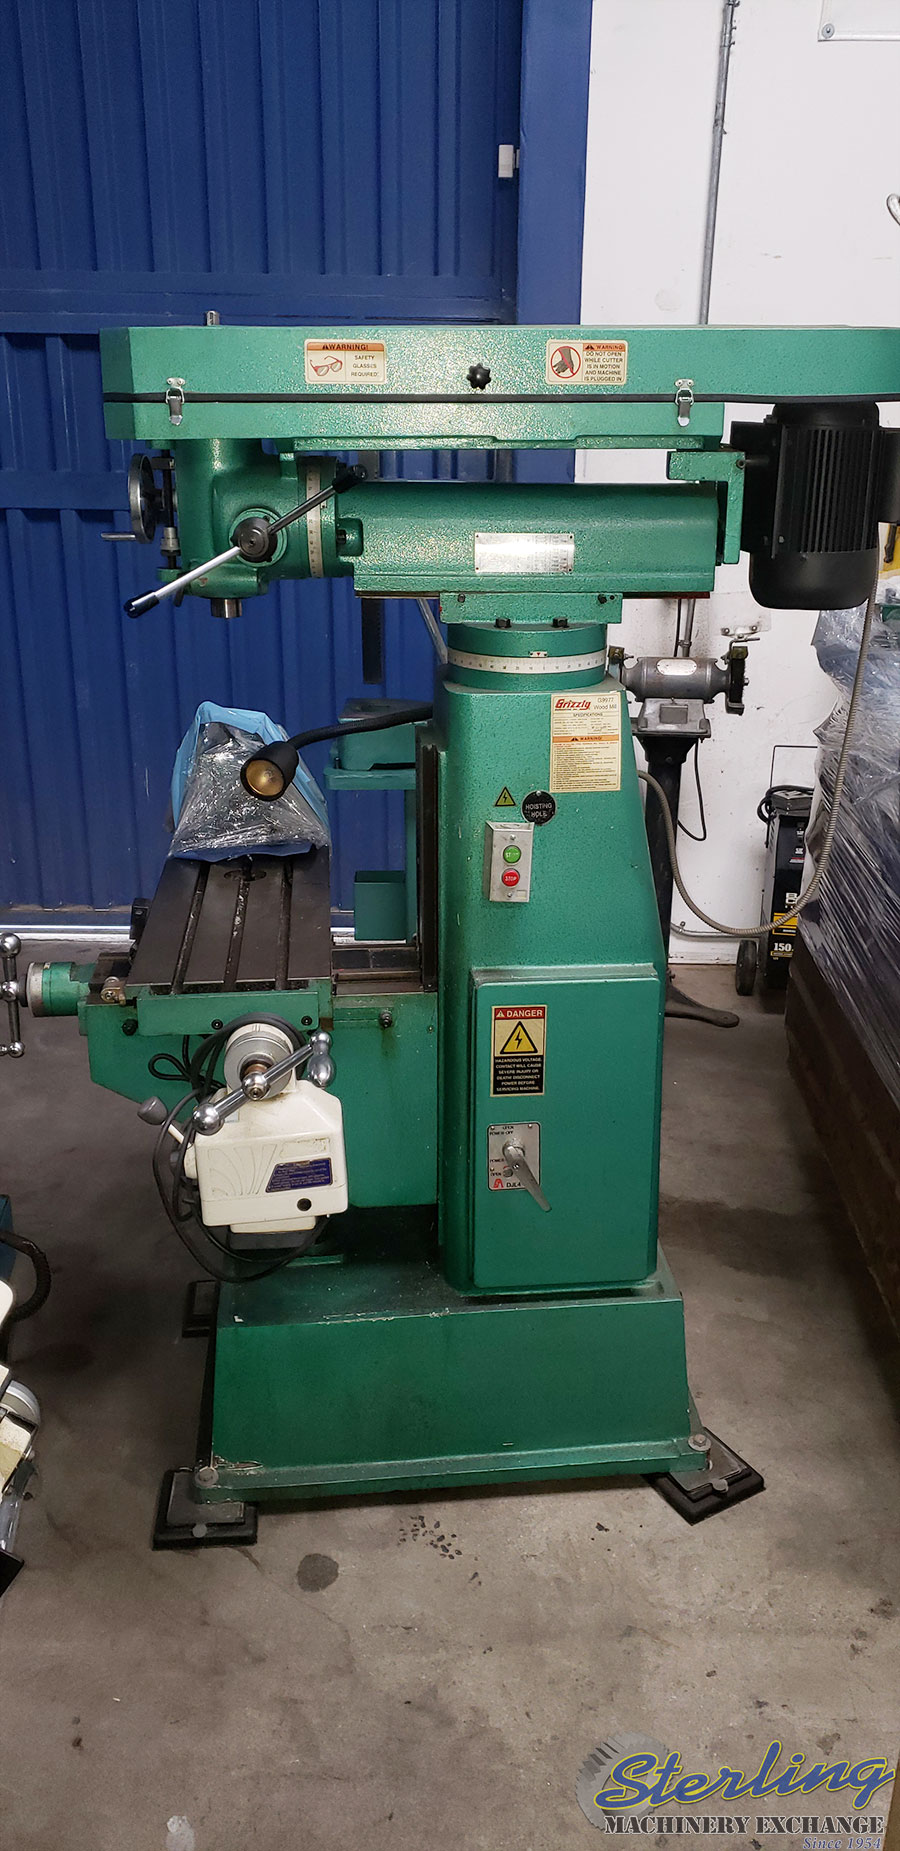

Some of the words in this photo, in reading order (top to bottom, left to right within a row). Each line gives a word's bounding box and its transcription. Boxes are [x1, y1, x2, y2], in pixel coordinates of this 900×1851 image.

[555, 698, 591, 710] Grizzly
[525, 802, 553, 810] HOISTING
[530, 810, 548, 818] HOLE
[506, 1009, 543, 1018] DANGER
